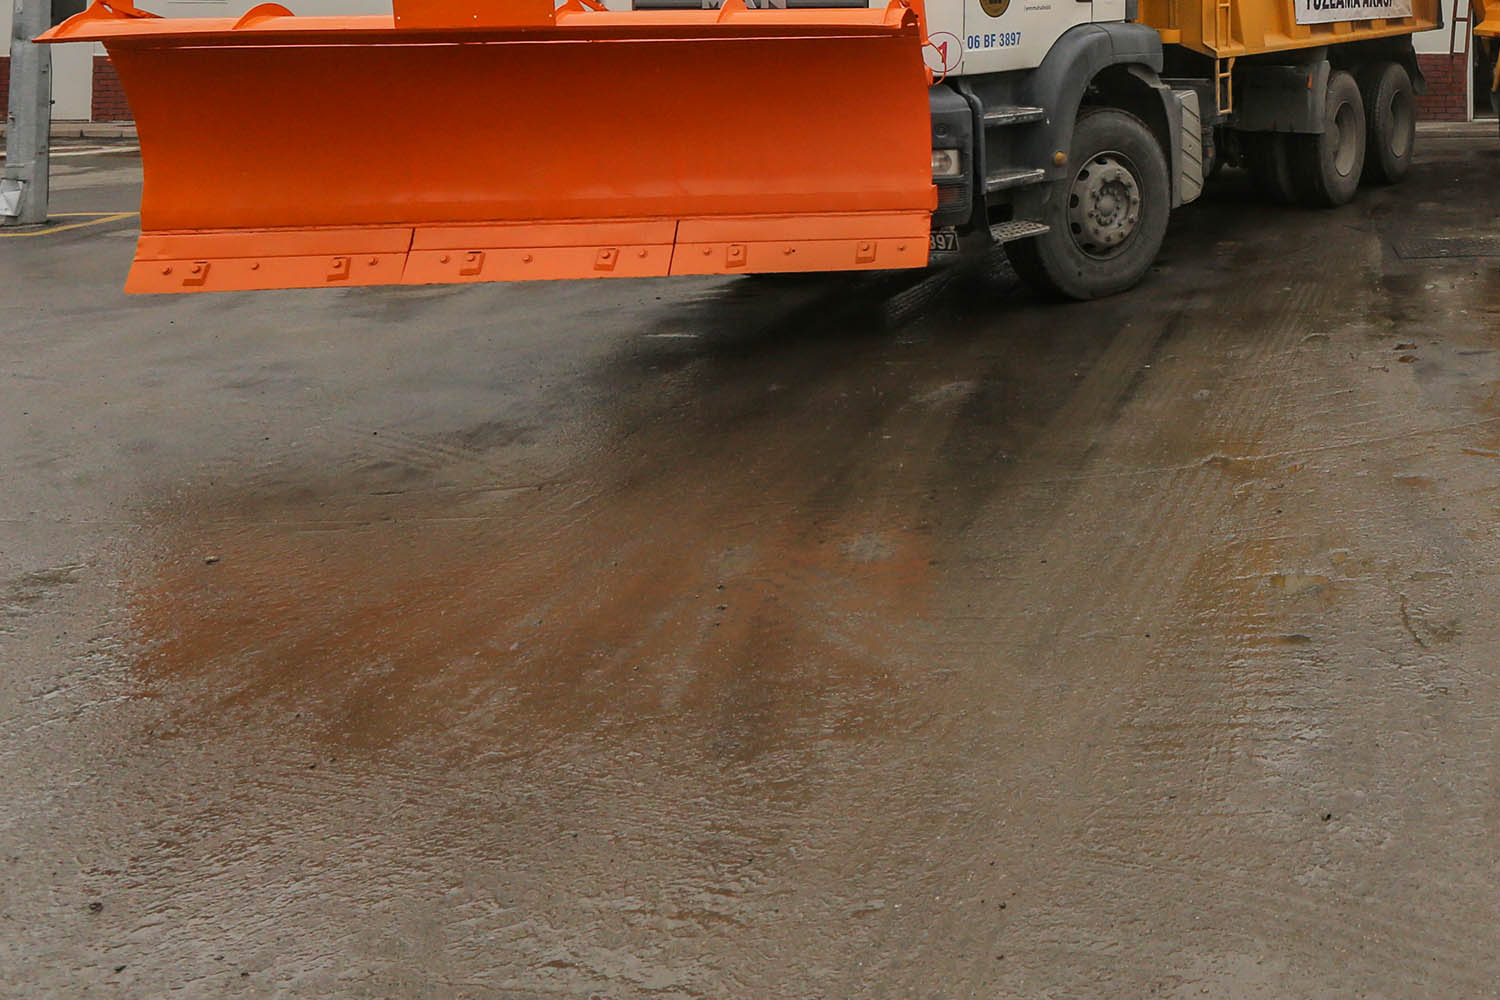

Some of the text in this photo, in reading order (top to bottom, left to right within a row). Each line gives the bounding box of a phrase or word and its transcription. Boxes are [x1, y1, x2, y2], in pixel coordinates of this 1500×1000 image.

[967, 32, 1021, 49] 06 BF 3897
